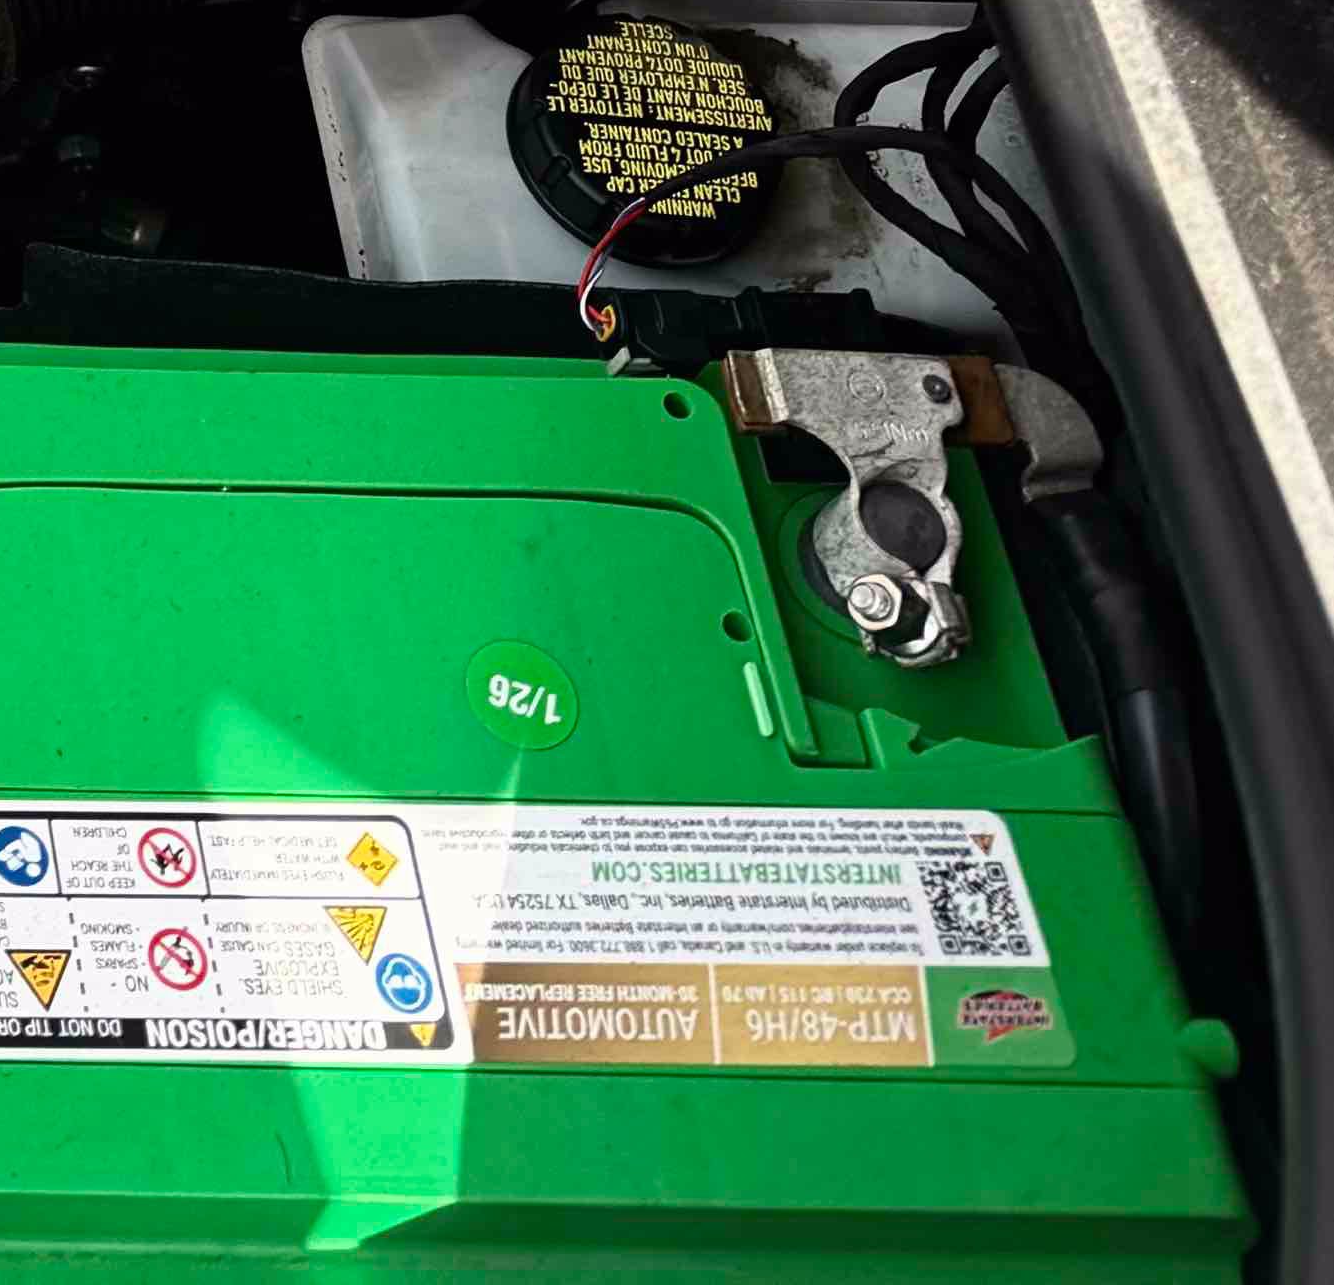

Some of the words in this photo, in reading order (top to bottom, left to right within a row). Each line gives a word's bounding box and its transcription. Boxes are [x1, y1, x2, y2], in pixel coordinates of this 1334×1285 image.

[586, 34, 671, 57] CONTENANT
[675, 42, 709, 60] D'UN
[558, 48, 642, 69] PROVENANT
[561, 64, 581, 80] DU
[587, 66, 614, 83] QUE
[686, 58, 743, 79] LIQUIDE
[601, 83, 619, 100] LE
[623, 85, 641, 101] DE
[712, 77, 745, 95] SER.
[546, 95, 566, 112] LE
[646, 87, 691, 106] AVANT
[696, 91, 764, 113] BOUCHON
[569, 96, 643, 119] NETTOYER
[648, 104, 772, 132] AVERTISSEMENT:
[583, 121, 672, 144] CONTAINER.
[675, 130, 730, 151] SEALED
[733, 136, 743, 147] A
[578, 138, 621, 156] FROM
[625, 141, 668, 159] FLUID
[671, 147, 681, 162] 4
[582, 156, 611, 173] USE
[605, 175, 634, 194] CAP
[693, 184, 741, 203] CLEAN
[488, 673, 561, 725] 1/26
[116, 843, 131, 855] OF
[71, 859, 109, 872] REACH
[113, 860, 133, 872] THE
[591, 862, 901, 885] INTERSTATEBATTERIES.COM
[65, 876, 78, 888] OF
[79, 876, 103, 889] OUT
[111, 877, 136, 889] KEEP
[507, 893, 551, 910] 75254
[555, 894, 574, 910] TX
[578, 892, 628, 910] Dallas,
[631, 892, 661, 910] Inc.,
[664, 894, 734, 911] Batteries,
[738, 895, 807, 911] Interstate
[812, 893, 826, 912] by
[832, 896, 912, 914] Distributed
[80, 923, 133, 935] SMOKING
[90, 939, 135, 952] FLAMES
[220, 940, 254, 952] CAUSE
[281, 941, 334, 959] GASES
[94, 957, 137, 970] SPARKS
[252, 959, 339, 976] EXPLOSIVE
[125, 975, 149, 992] NO
[288, 978, 343, 996] SHIELD
[463, 982, 573, 1002] REPLACEMENT
[577, 984, 612, 1002] FREE
[22, 1018, 53, 1036] TIP
[59, 1017, 91, 1036] NOT
[98, 1018, 122, 1038] DO
[496, 1006, 698, 1041] AUTOMOTIVE
[745, 1008, 917, 1043] MTP-48/H6
[145, 1018, 387, 1050] DANGER/POISON
